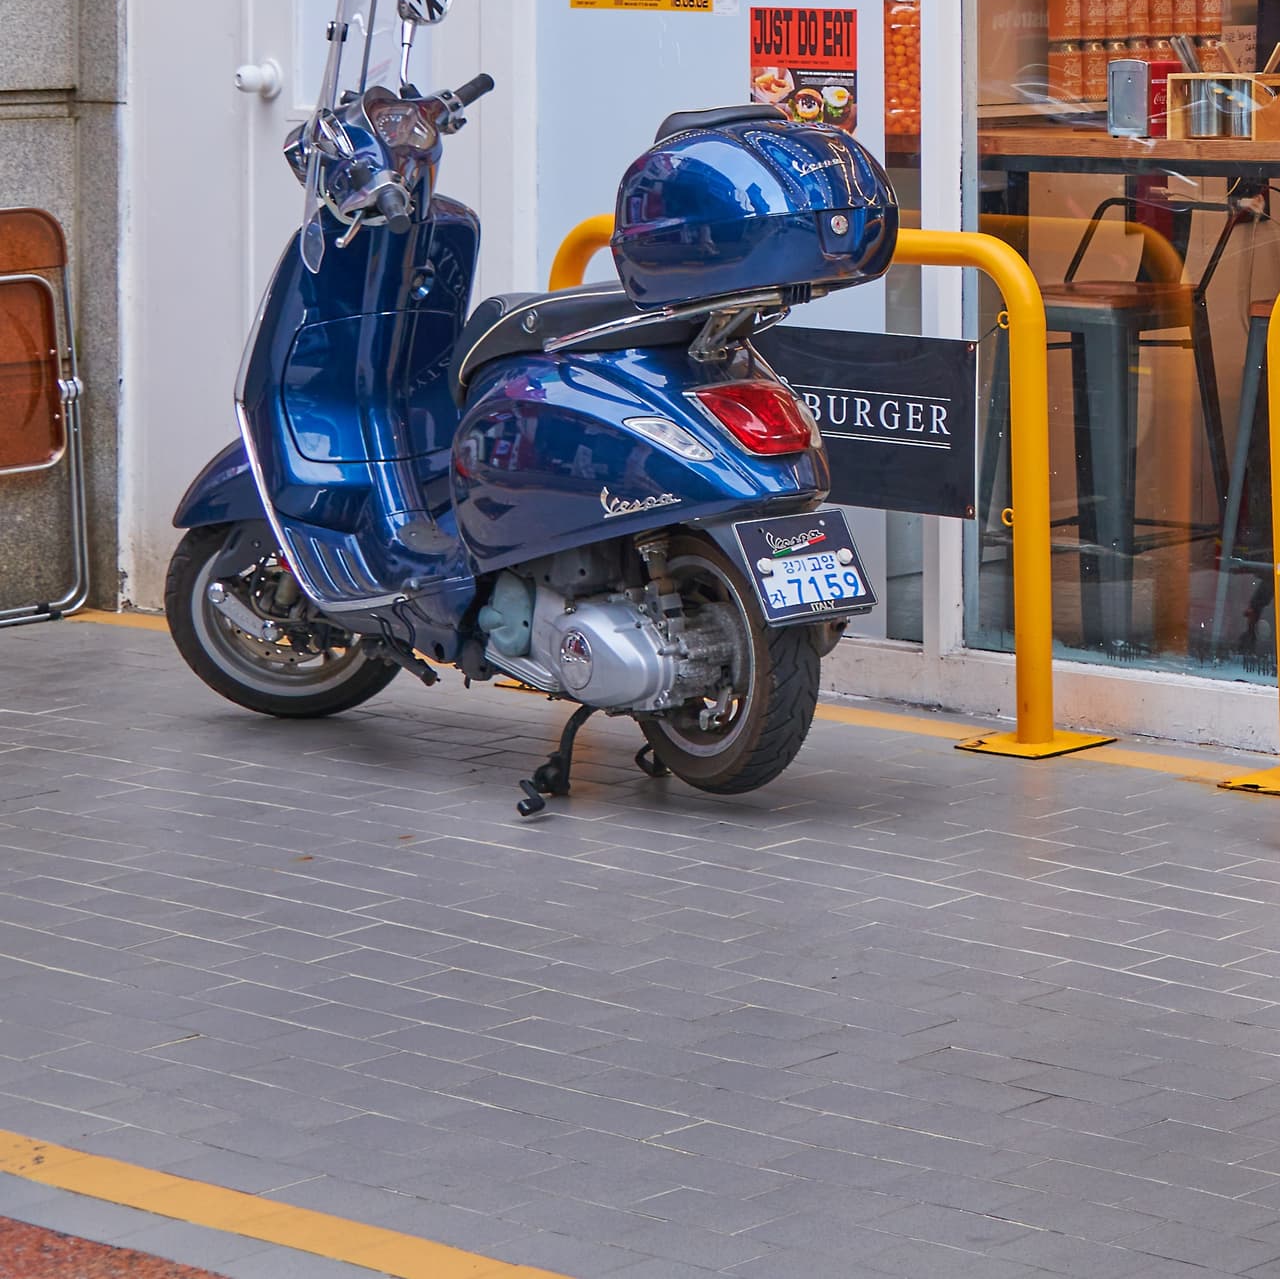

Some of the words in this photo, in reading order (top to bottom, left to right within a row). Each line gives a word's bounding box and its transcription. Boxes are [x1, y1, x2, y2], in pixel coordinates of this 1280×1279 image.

[754, 9, 793, 55] JUST
[798, 10, 818, 56] DO
[823, 11, 854, 57] EAT
[803, 392, 951, 436] BURGER
[600, 486, 682, 518] Vespa
[766, 529, 825, 555] Vespa
[770, 589, 787, 606] 자
[787, 571, 860, 605] 7159
[811, 601, 835, 611] ITALY
